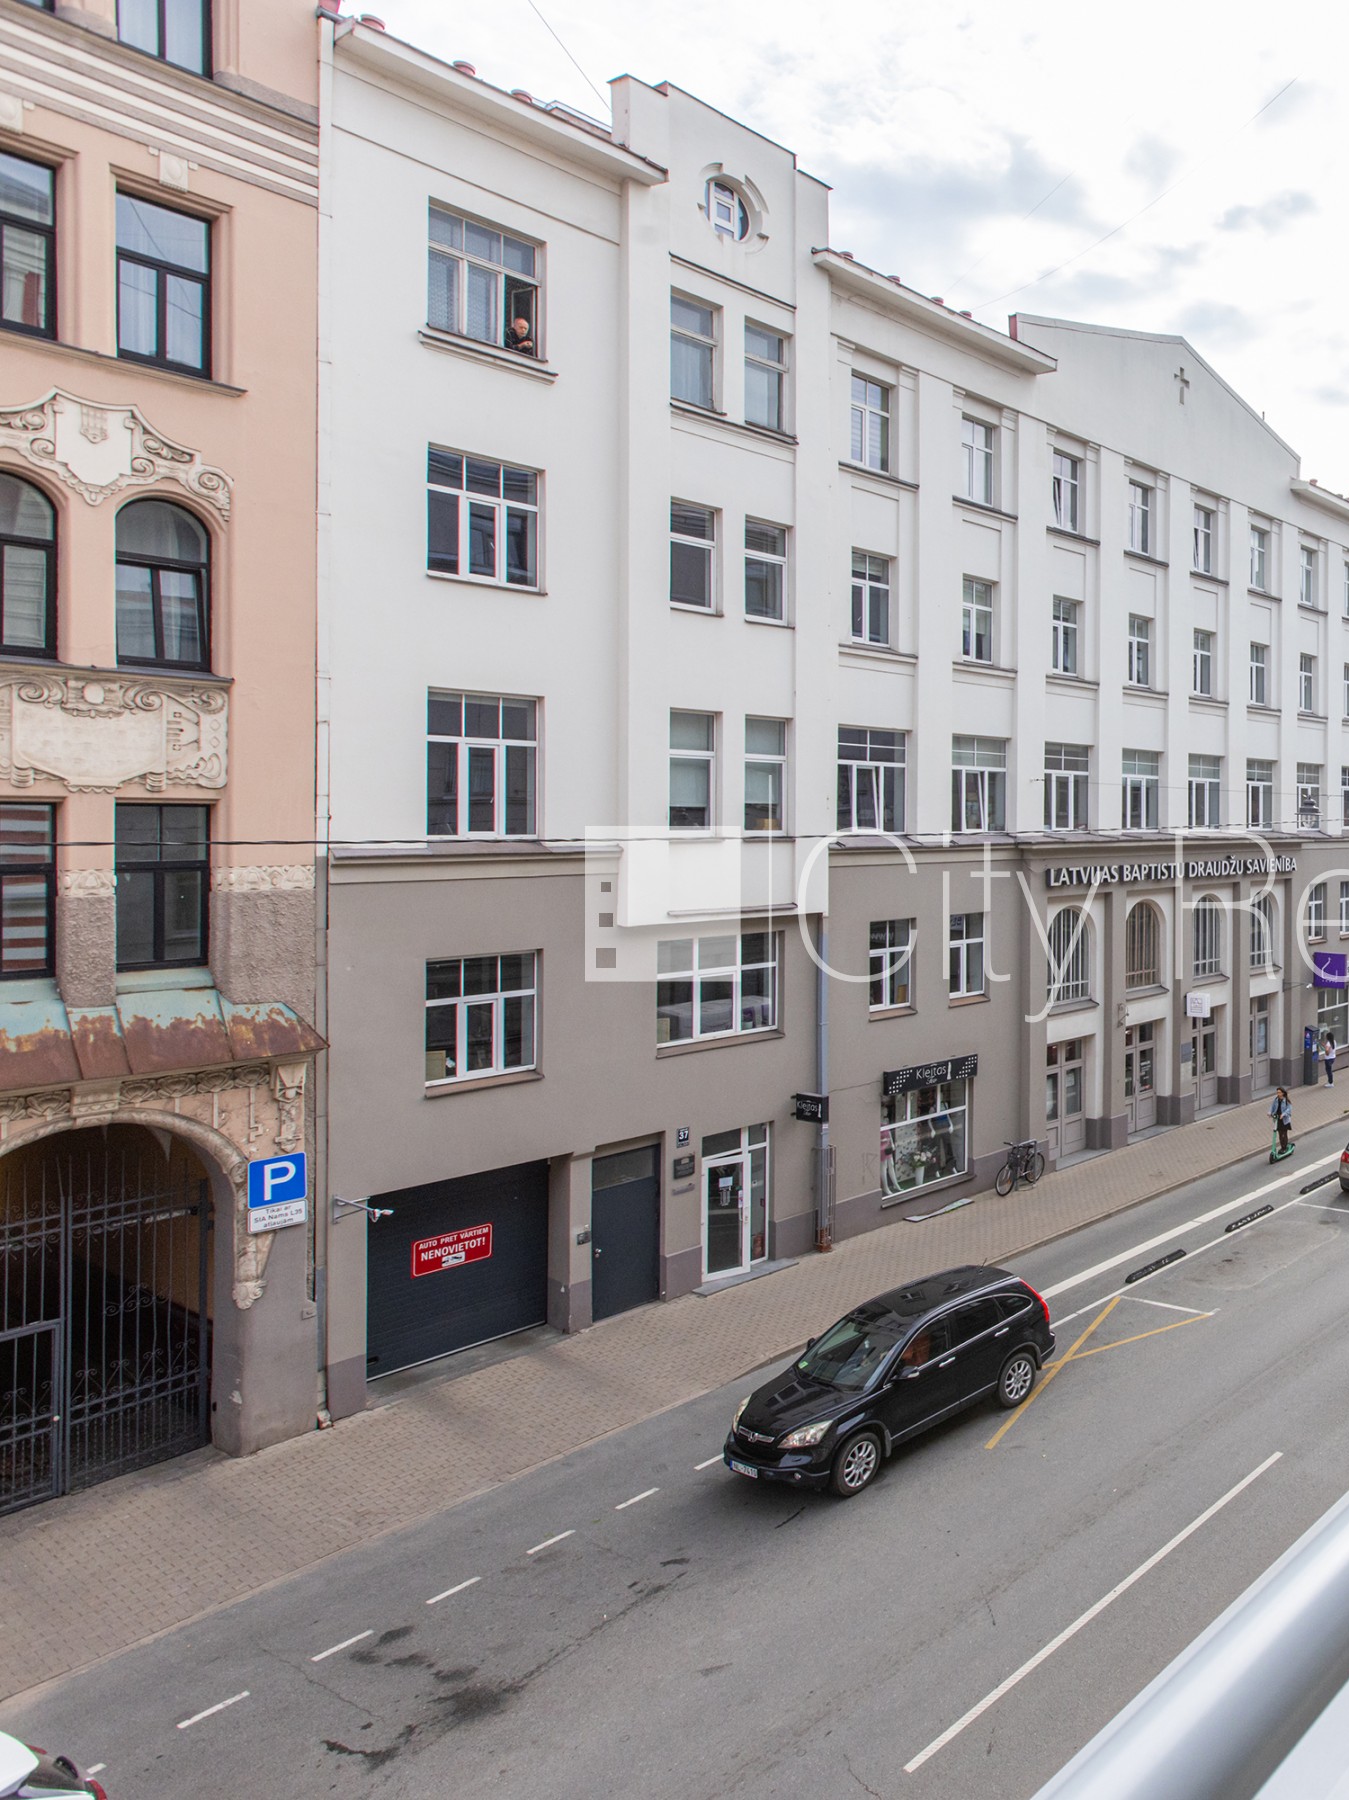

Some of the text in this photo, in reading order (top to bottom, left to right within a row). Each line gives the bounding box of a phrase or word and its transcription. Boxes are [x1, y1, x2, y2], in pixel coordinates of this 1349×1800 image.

[1050, 855, 1297, 887] LATVIJAS BAPTISTU DRAUDŽU SAVIENĪBA
[916, 1065, 946, 1080] Kleitas
[679, 1130, 689, 1140] 37
[264, 1161, 296, 1201] P
[266, 1206, 282, 1214] Tikai
[419, 1227, 489, 1250] AUTO PRET VĀRTIEM
[421, 1237, 486, 1262] NENOVIETOT!
